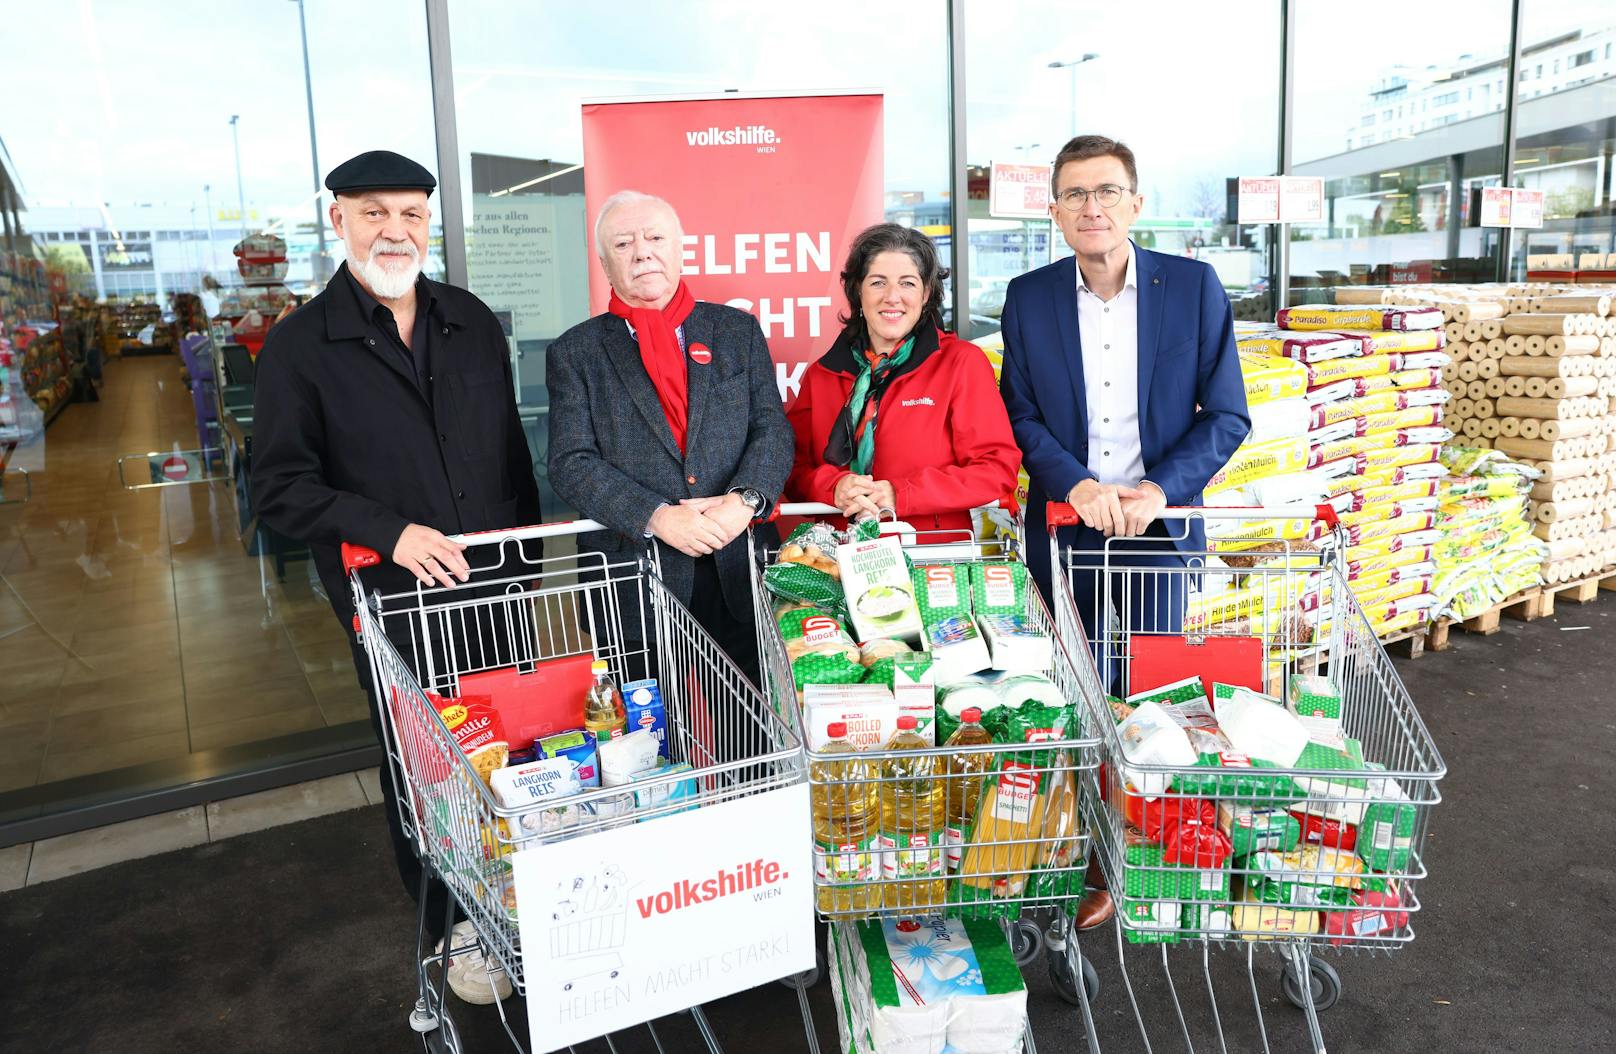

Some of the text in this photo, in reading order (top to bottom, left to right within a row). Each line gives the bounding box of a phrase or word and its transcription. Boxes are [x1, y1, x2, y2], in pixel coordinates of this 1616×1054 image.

[686, 126, 781, 146] volkshilfe.
[505, 210, 529, 221] allen
[503, 225, 552, 236] Regionen.
[681, 231, 831, 276] ELFEN
[1295, 315, 1327, 325] Paradiso
[853, 556, 897, 575] LANGKORN
[805, 630, 838, 642] BUDGET
[454, 716, 491, 740] milie
[848, 719, 881, 732] BOILED
[849, 732, 880, 745] GKORN
[512, 769, 562, 789] LANGKORN
[528, 782, 557, 798] REIS
[636, 858, 789, 918] volkshilfe.
[753, 886, 783, 903] WIEN
[558, 930, 791, 1025] HELFEN MACHT STARK!
